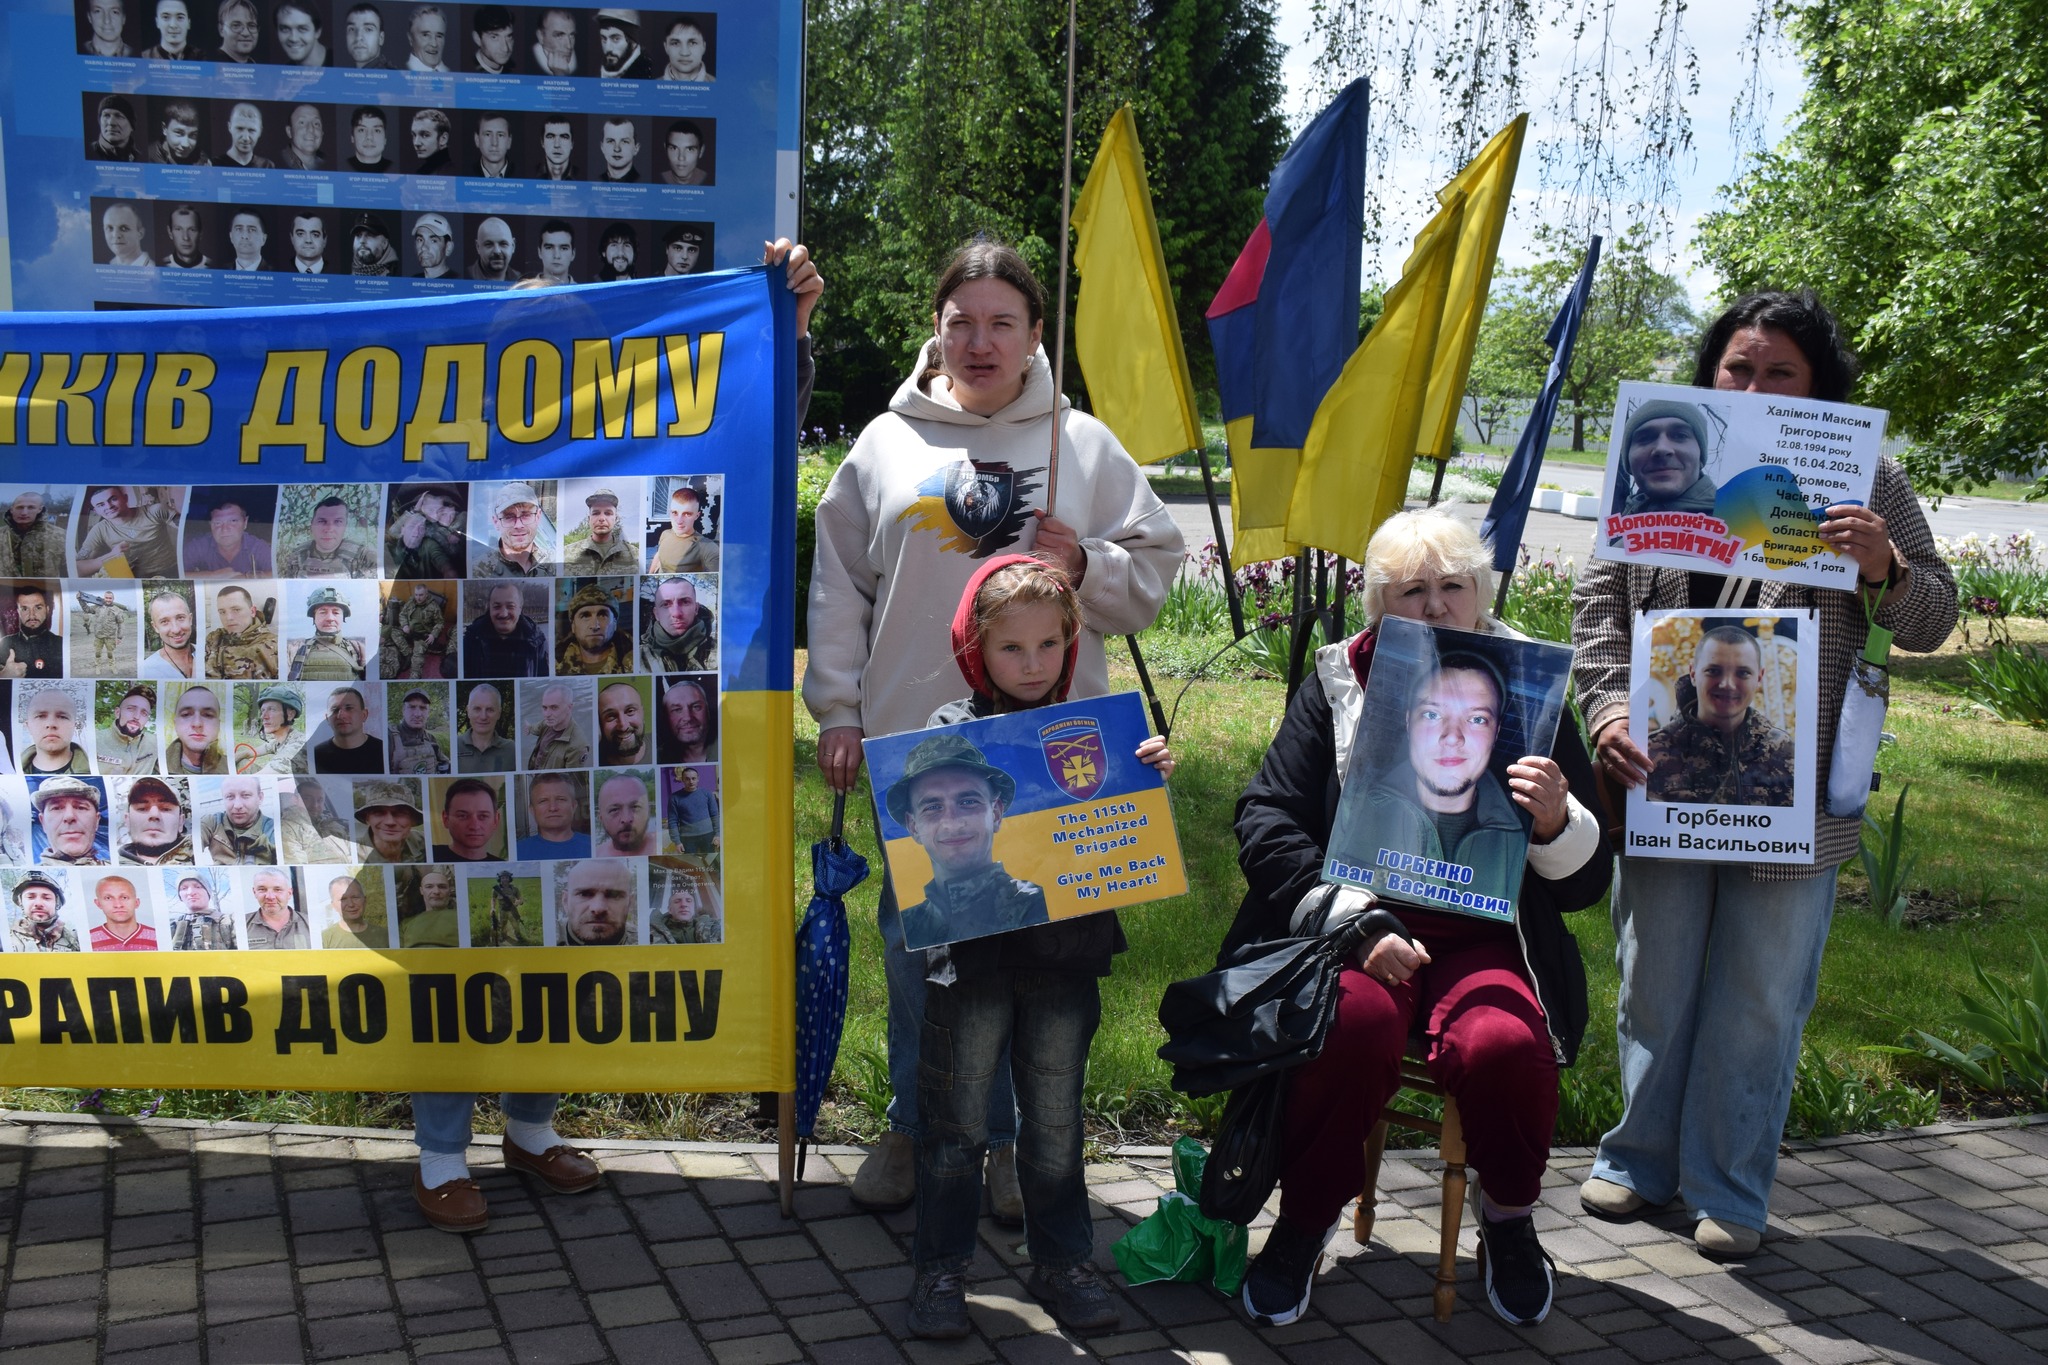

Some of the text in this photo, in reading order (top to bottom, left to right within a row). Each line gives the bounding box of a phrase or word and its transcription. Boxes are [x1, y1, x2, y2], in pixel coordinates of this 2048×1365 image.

[239, 331, 726, 465] ДОДОМУ
[1766, 405, 1872, 429] Халімон Максим
[1780, 424, 1852, 443] Григорович
[1775, 440, 1852, 458] 12.08.1994 року
[1758, 452, 1862, 477] Зник 16.04.2023,
[1765, 472, 1850, 492] н.п. Хромове,
[1776, 489, 1810, 502] Часів
[1764, 539, 1826, 557] Бригада 57,
[1743, 552, 1845, 573] 1 батальйон, 1 рота
[1057, 801, 1136, 826] The 115th
[1665, 807, 1772, 829] Горбенко
[1052, 814, 1148, 844] Mechanized
[1074, 834, 1138, 856] Brigade
[1629, 831, 1811, 855] Іван Васильович
[1057, 855, 1166, 886] Give Me Back
[1376, 848, 1474, 885] ГОРБЕНКО
[1076, 872, 1158, 899] My Heart!
[1328, 859, 1511, 916] Іван Васильович
[0, 970, 723, 1055] РАПИВ ДО ПОЛОНУ
